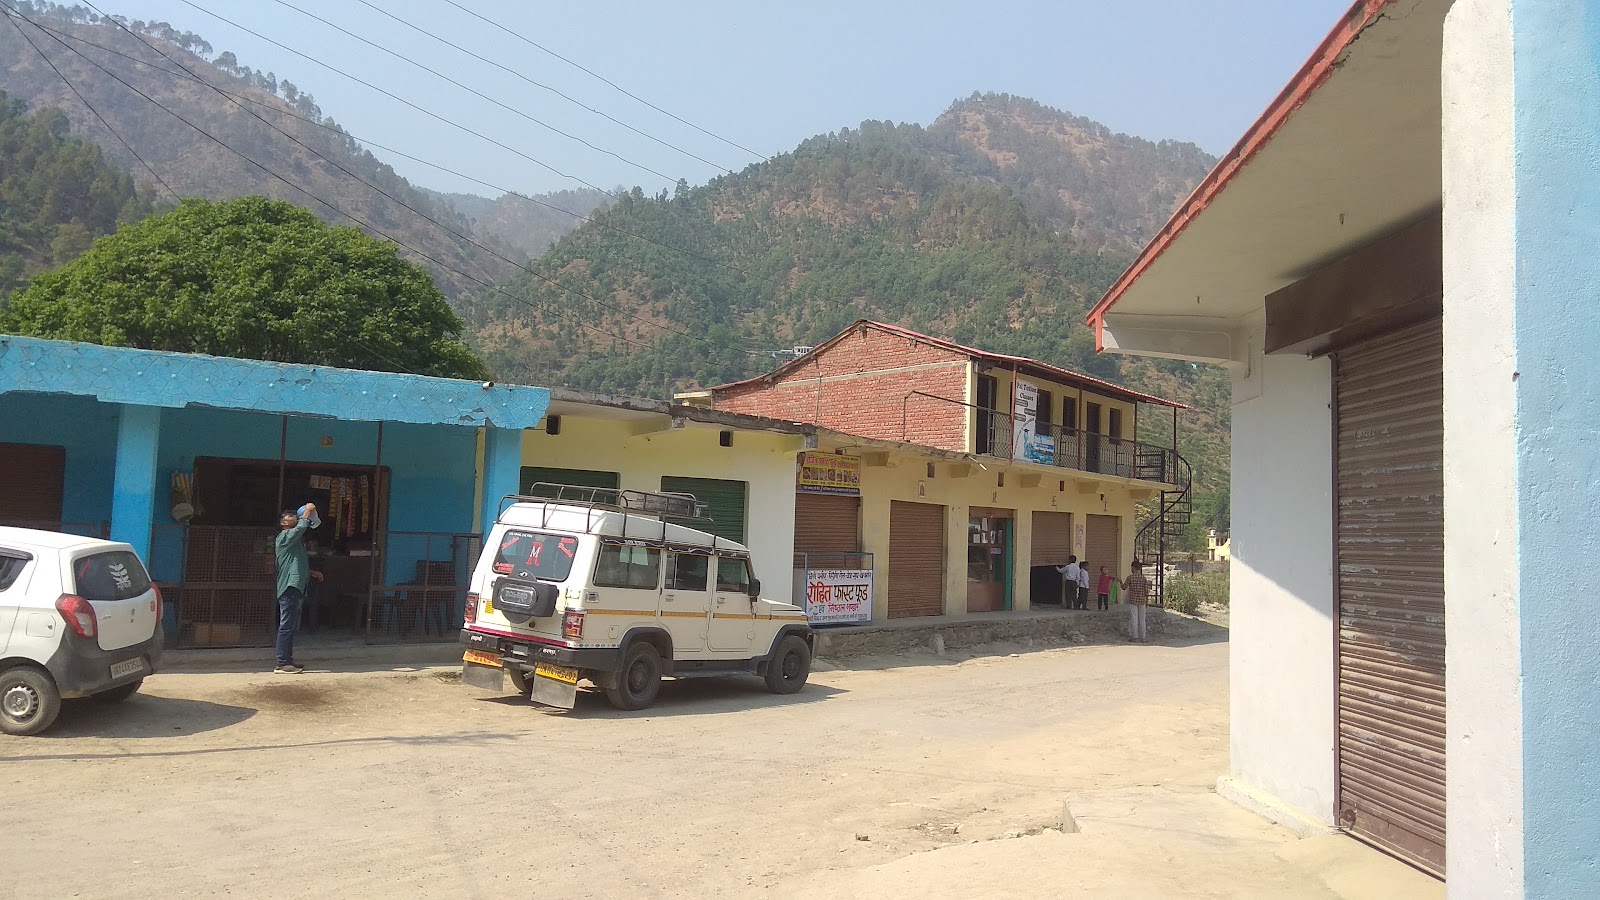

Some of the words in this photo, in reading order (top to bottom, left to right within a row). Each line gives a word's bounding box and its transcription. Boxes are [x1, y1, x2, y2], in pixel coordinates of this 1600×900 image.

[807, 581, 833, 604] रोहित
[833, 584, 855, 602] फास्ट
[855, 584, 869, 605] फूड
